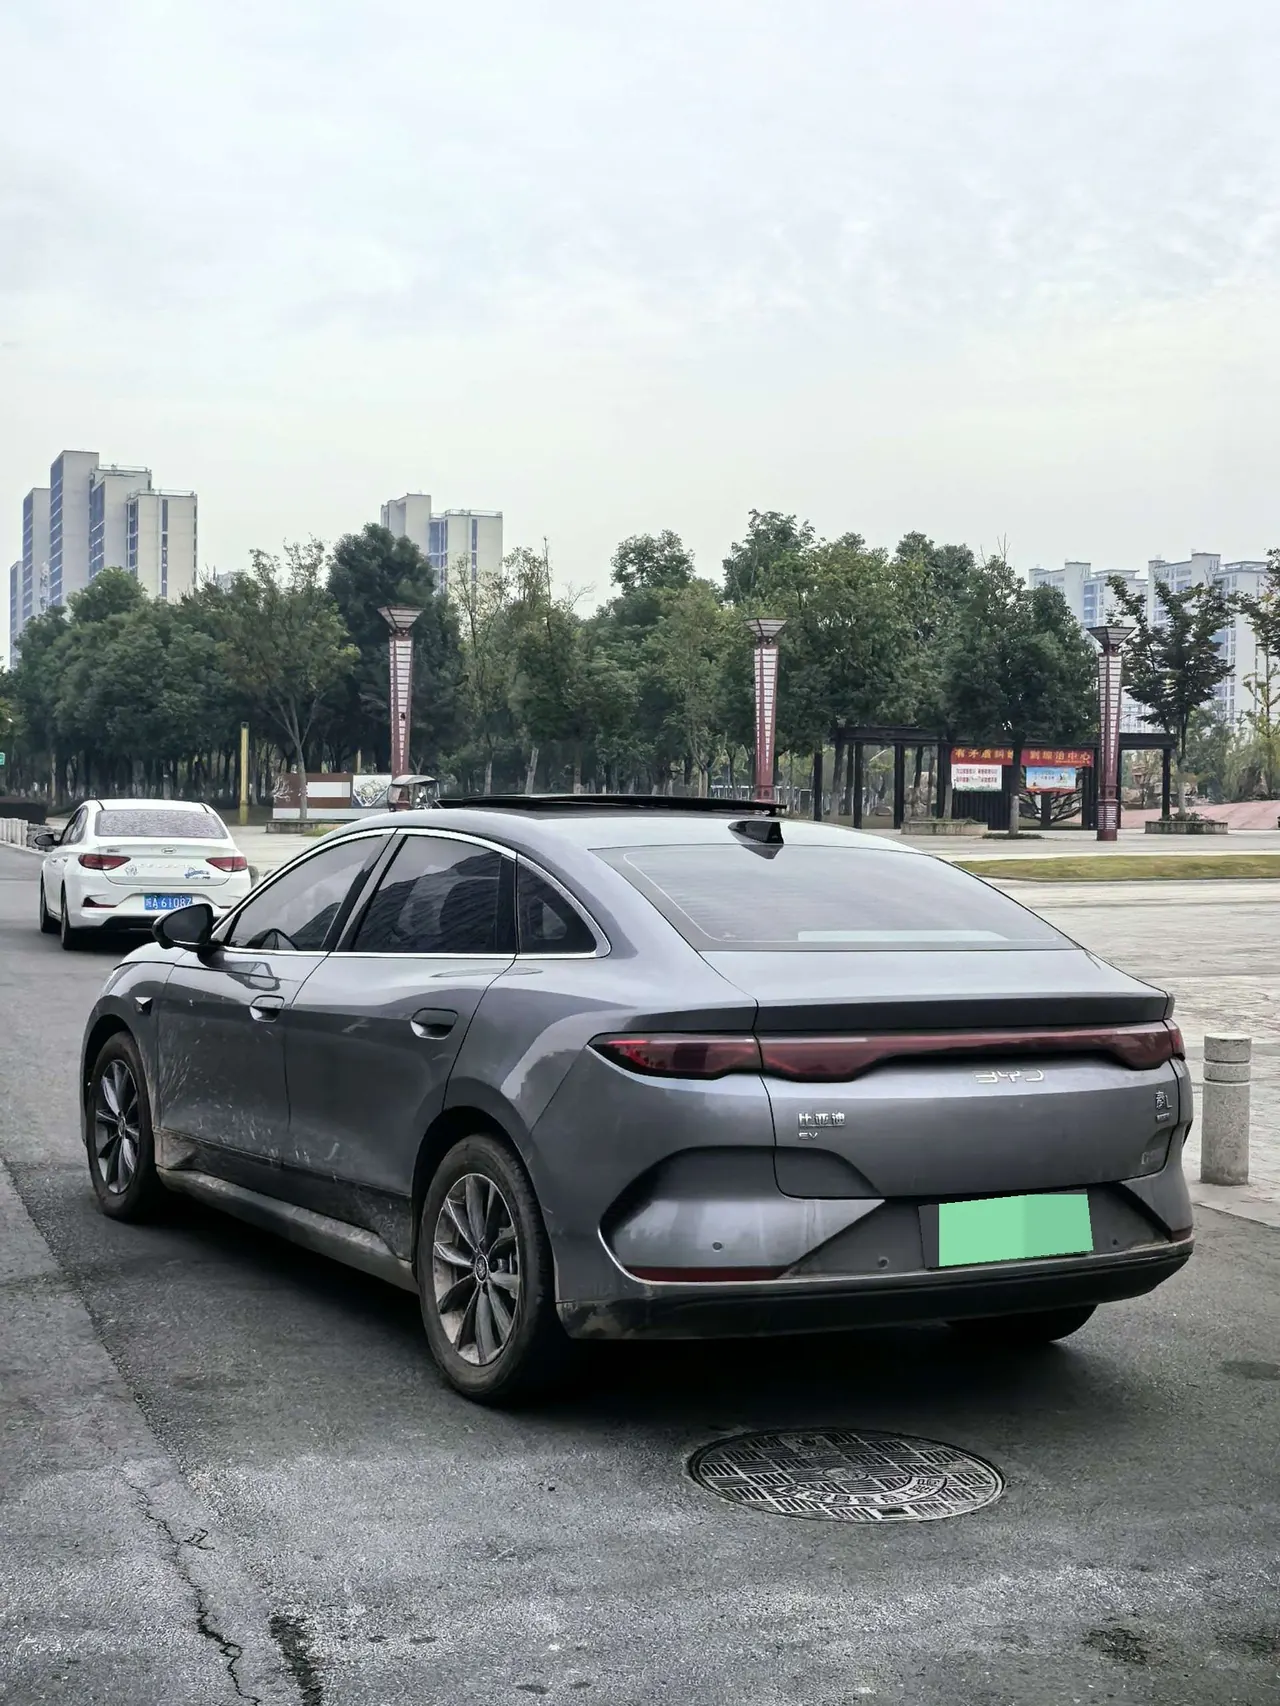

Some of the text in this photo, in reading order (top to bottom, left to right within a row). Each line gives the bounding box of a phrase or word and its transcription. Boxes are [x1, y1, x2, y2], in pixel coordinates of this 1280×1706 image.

[973, 1069, 1045, 1083] BYD
[798, 1111, 846, 1126] 比亚迪
[798, 1132, 818, 1140] EV
